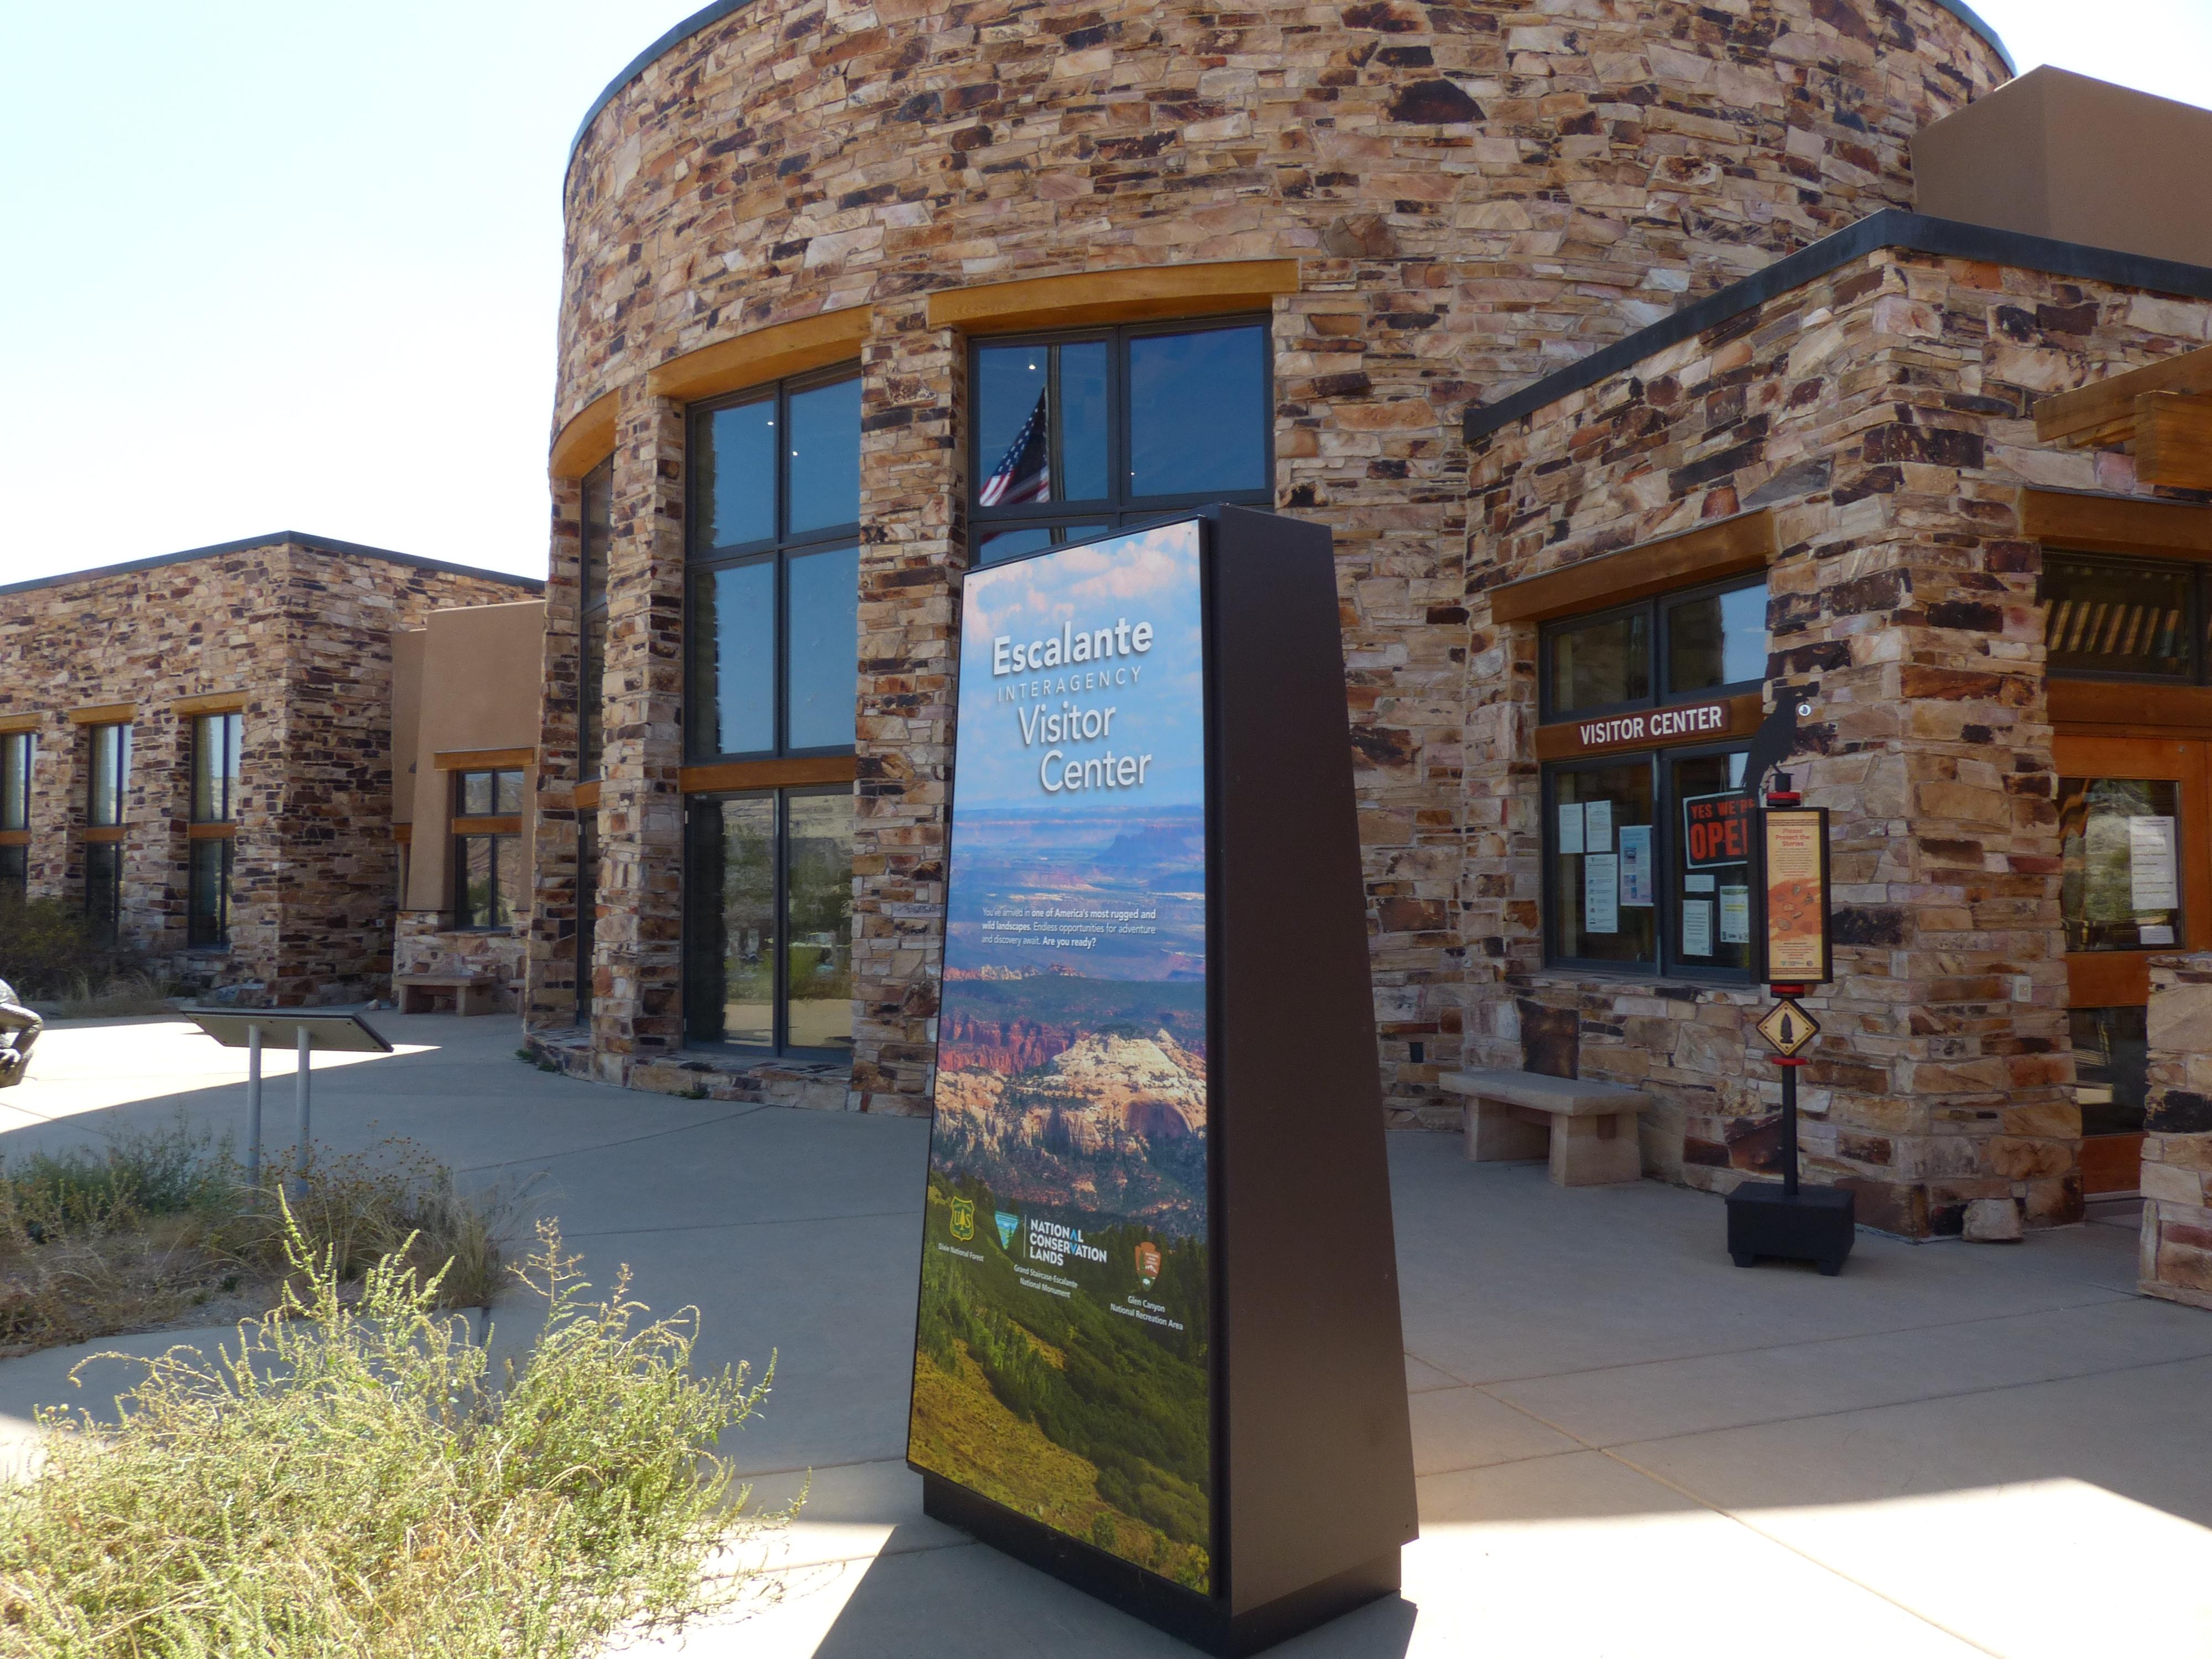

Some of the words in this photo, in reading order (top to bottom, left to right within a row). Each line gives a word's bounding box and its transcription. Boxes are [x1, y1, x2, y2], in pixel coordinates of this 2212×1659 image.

[993, 618, 1153, 676] Escalante
[998, 665, 1141, 702] INTERAGENCY
[1018, 701, 1117, 744] Visitor
[1580, 717, 1644, 745] VISITOR
[1650, 706, 1722, 736] CENTER
[1041, 749, 1152, 791] Center
[1691, 804, 1713, 819] YES
[983, 908, 1001, 917] You've
[1003, 908, 1022, 917] arrived
[1024, 909, 1031, 917] in
[1046, 909, 1053, 917] of
[1055, 909, 1088, 918] America's
[1090, 910, 1109, 918] most
[1111, 909, 1139, 921] rugged
[1141, 909, 1156, 919] and
[982, 921, 995, 930] wild
[996, 921, 1032, 933] landscapes.
[1033, 922, 1057, 932] Endless
[1059, 923, 1104, 935] opportunities
[1106, 923, 1117, 933] for
[1118, 923, 1156, 934] adventure
[982, 935, 993, 943] and
[994, 935, 1021, 946] discovery
[1022, 937, 1041, 946] await.
[1042, 937, 1055, 946] Are
[1056, 939, 1070, 948] you
[1071, 937, 1097, 949] ready?
[1031, 1218, 1084, 1243] NATIONAL
[950, 1246, 969, 1258] National
[969, 1251, 984, 1261] Forest
[1030, 1233, 1107, 1264] CONSERVATION
[1030, 1246, 1064, 1266] LANDS
[1014, 1264, 1029, 1275] Grand
[1030, 1269, 1078, 1288] Staircase-Escalante
[1020, 1277, 1041, 1290] National
[1041, 1284, 1071, 1298] Monument
[1128, 1296, 1141, 1306] Glen
[1142, 1300, 1165, 1313] Canyon
[1110, 1303, 1135, 1317] National
[1136, 1310, 1167, 1326] Recreation
[1168, 1319, 1183, 1331] Area
